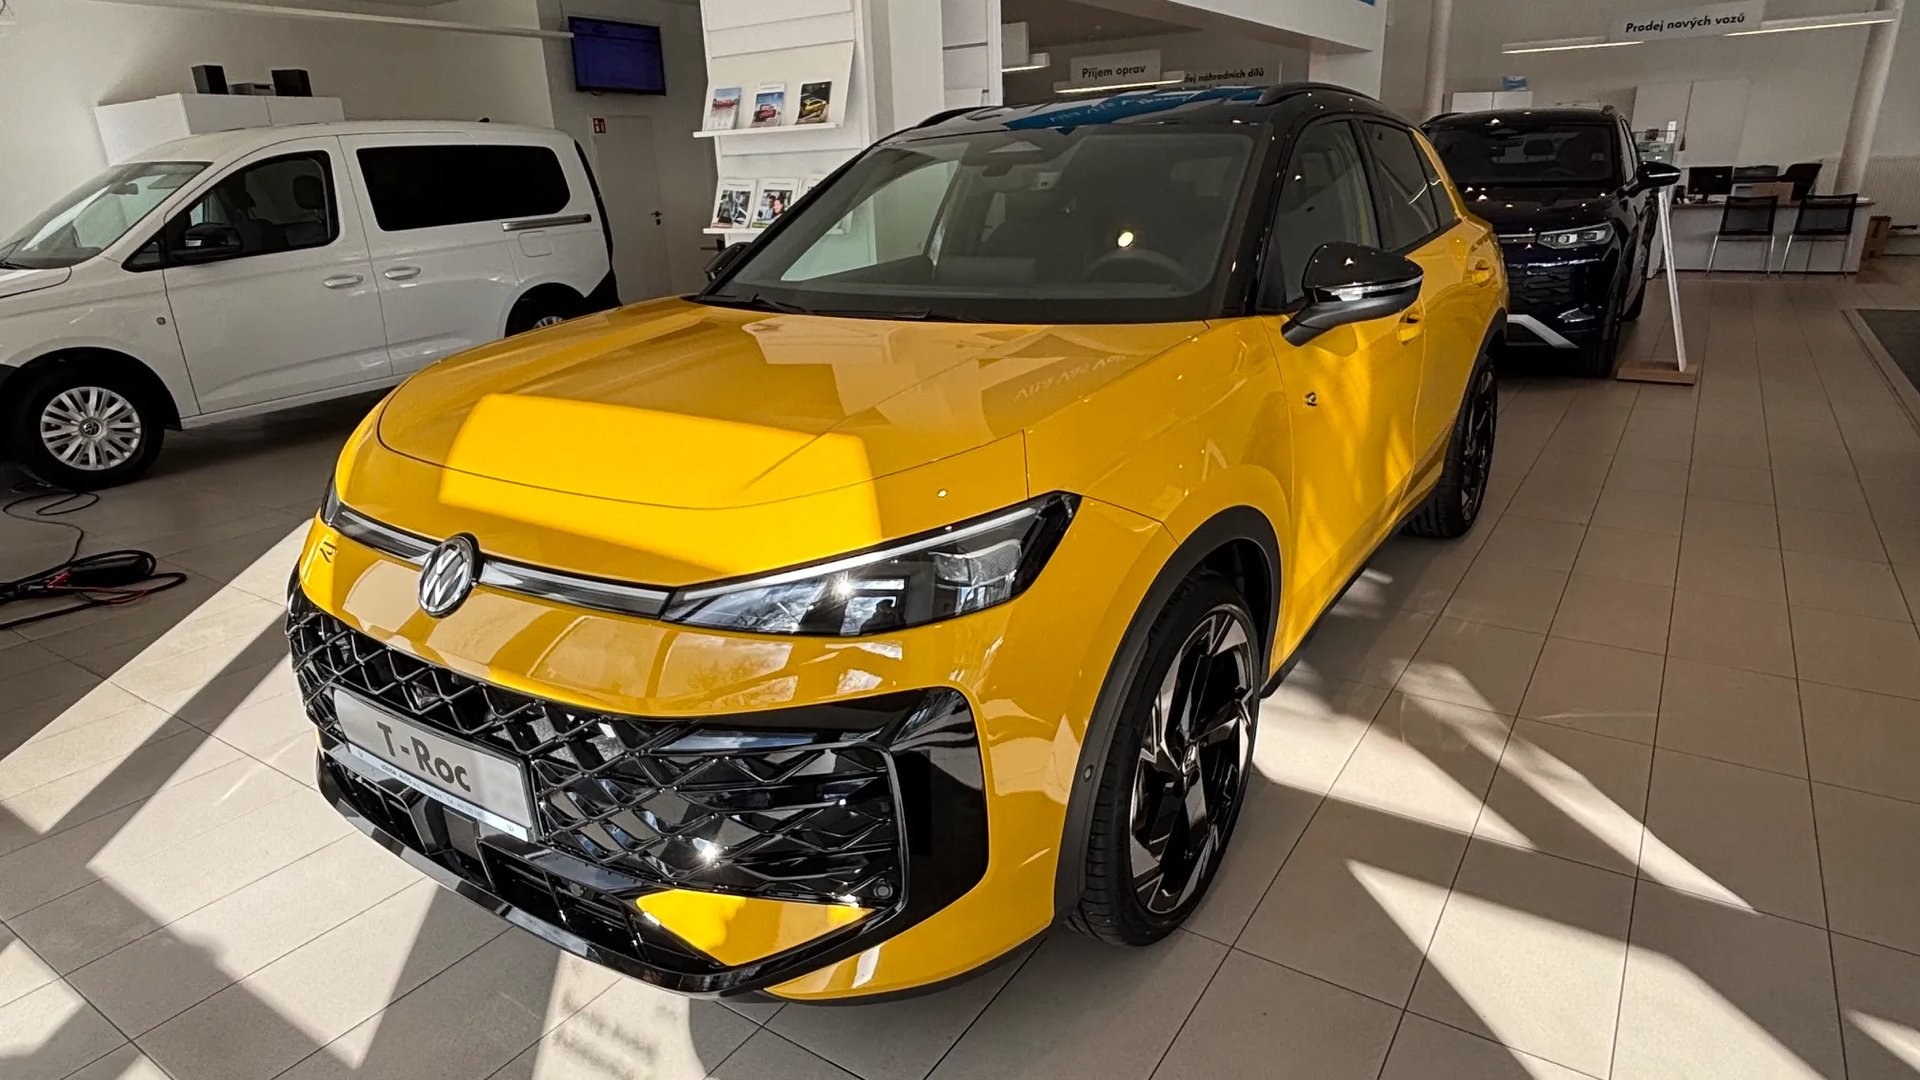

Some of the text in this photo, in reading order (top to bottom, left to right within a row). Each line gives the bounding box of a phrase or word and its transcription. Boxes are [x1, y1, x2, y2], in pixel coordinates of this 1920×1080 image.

[1625, 13, 1746, 33] Prodej nových vozů
[1116, 65, 1146, 77] oprav
[376, 721, 471, 792] T-Roc
